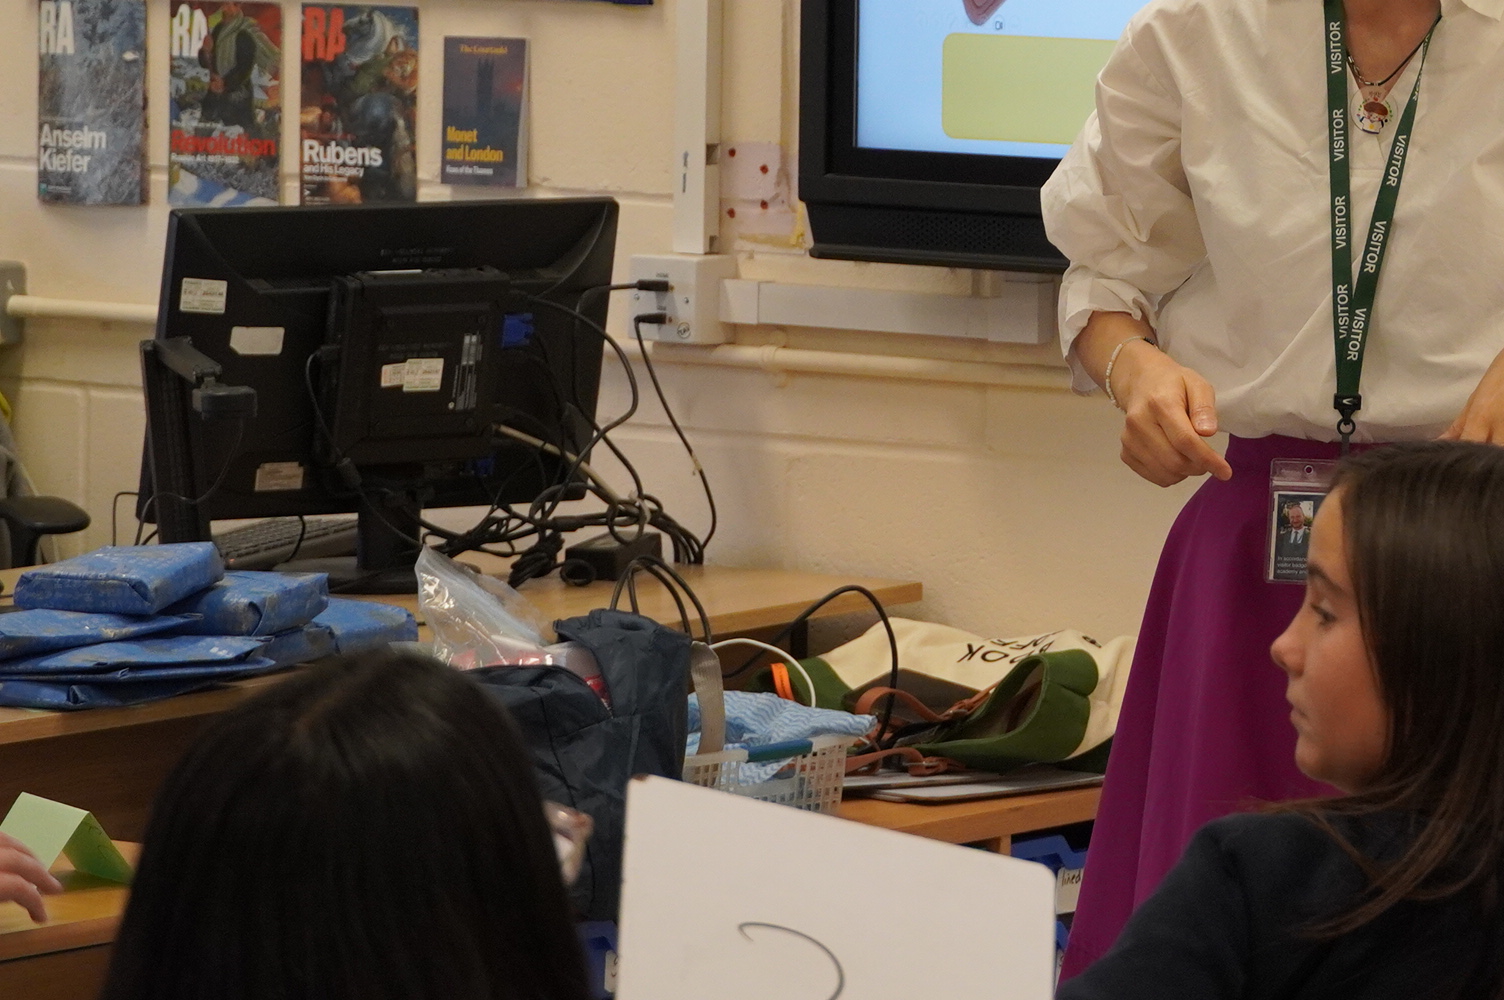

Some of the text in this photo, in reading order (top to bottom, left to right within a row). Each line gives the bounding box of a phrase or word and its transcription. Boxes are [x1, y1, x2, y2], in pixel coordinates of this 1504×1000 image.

[40, 1, 75, 54] RA
[302, 6, 347, 62] RA
[1329, 21, 1341, 74] VISITOR
[40, 123, 107, 149] Anselm
[40, 147, 91, 173] Kiefer
[171, 129, 276, 156] Revolution
[303, 138, 383, 167] Rubens
[446, 125, 478, 142] Monet
[446, 143, 504, 163] and London
[1333, 108, 1344, 161] VISITOR
[303, 163, 319, 173] and
[334, 165, 365, 178] Legacy
[1386, 134, 1407, 187] VISITOR
[1335, 195, 1346, 249] VISITOR
[1364, 220, 1387, 274] VISITOR
[1339, 284, 1349, 339] VISITOR
[1347, 307, 1367, 361] VISITOR
